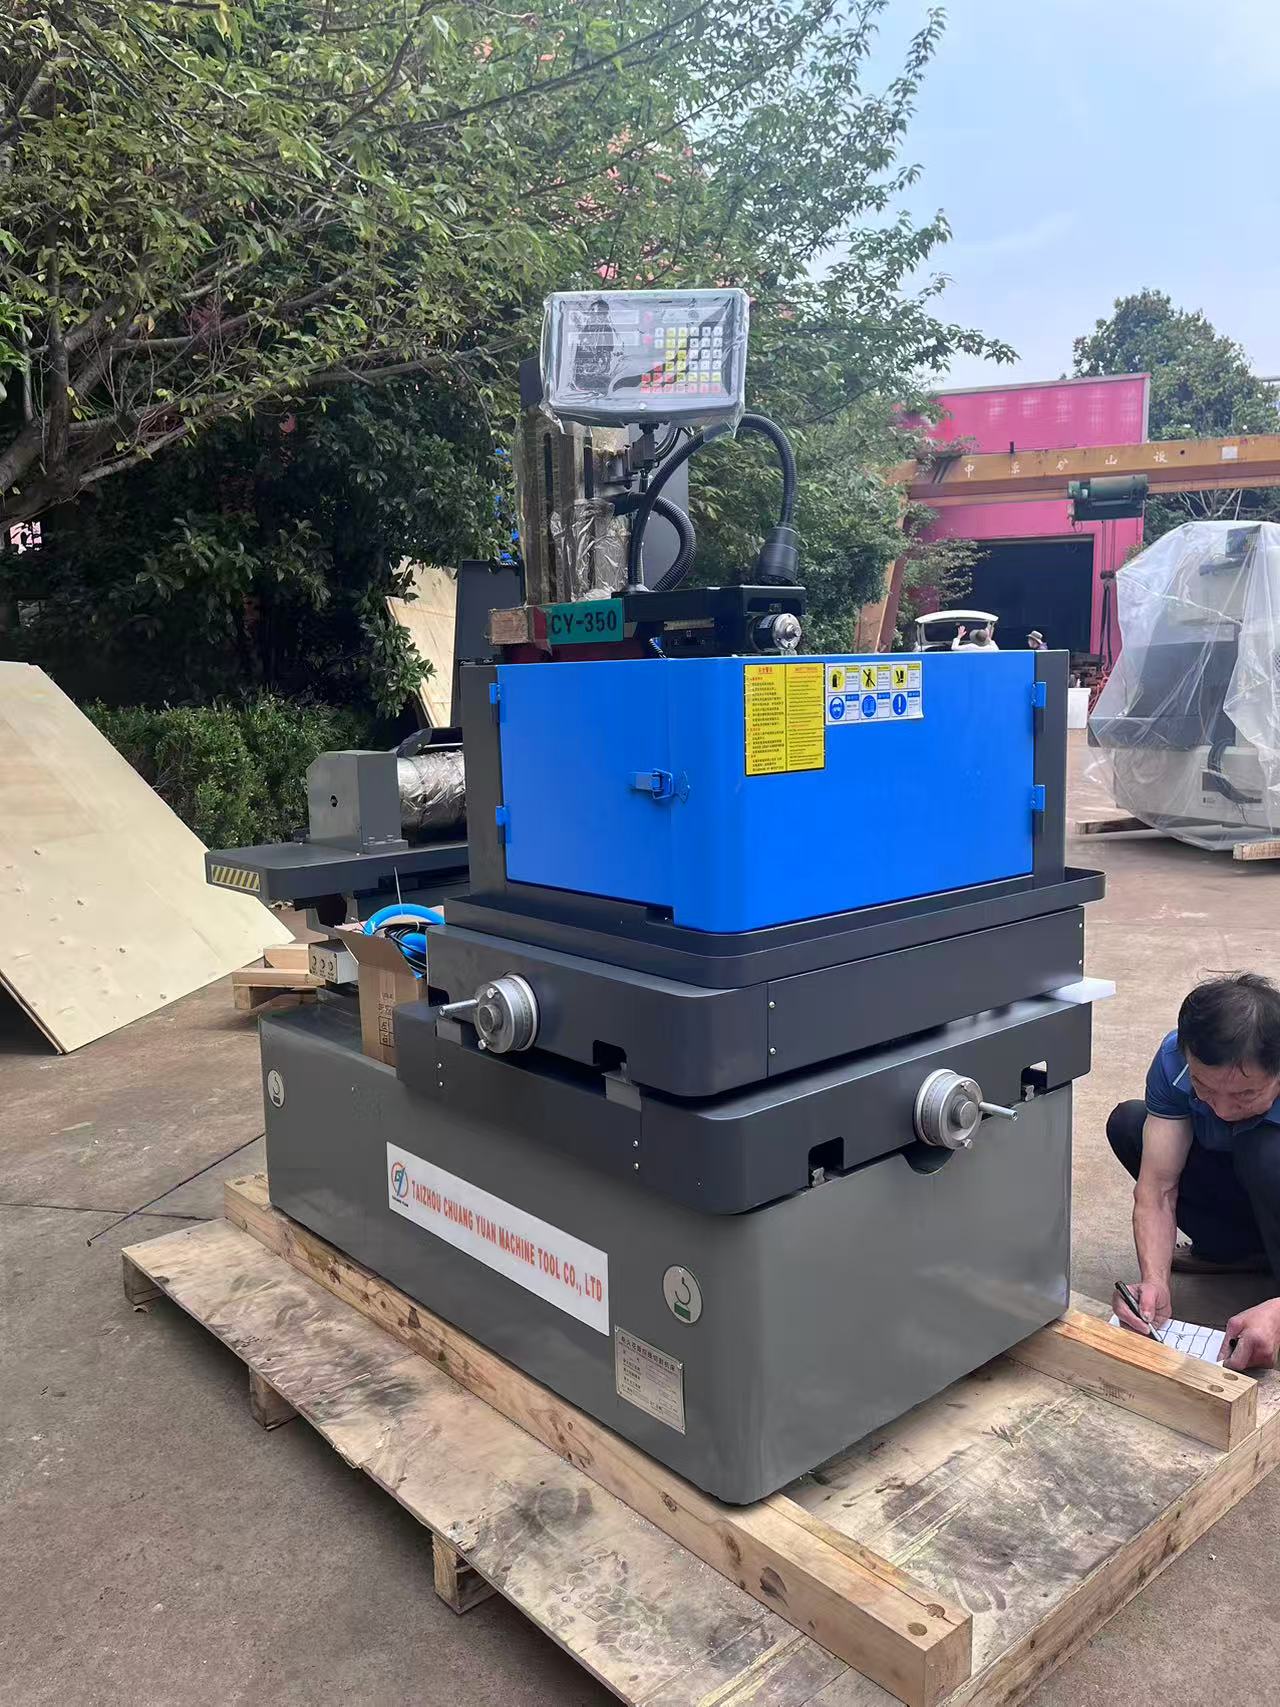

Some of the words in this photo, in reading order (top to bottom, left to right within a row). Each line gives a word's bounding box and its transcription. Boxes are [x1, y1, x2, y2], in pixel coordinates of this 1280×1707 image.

[551, 609, 617, 635] CY-350
[411, 1180, 442, 1213] TAIZHOU
[443, 1196, 473, 1231] CHUANG
[475, 1215, 497, 1244] YUAN
[498, 1226, 536, 1266] MACHINE
[537, 1247, 561, 1280] TOOL
[584, 1272, 603, 1302] LTD
